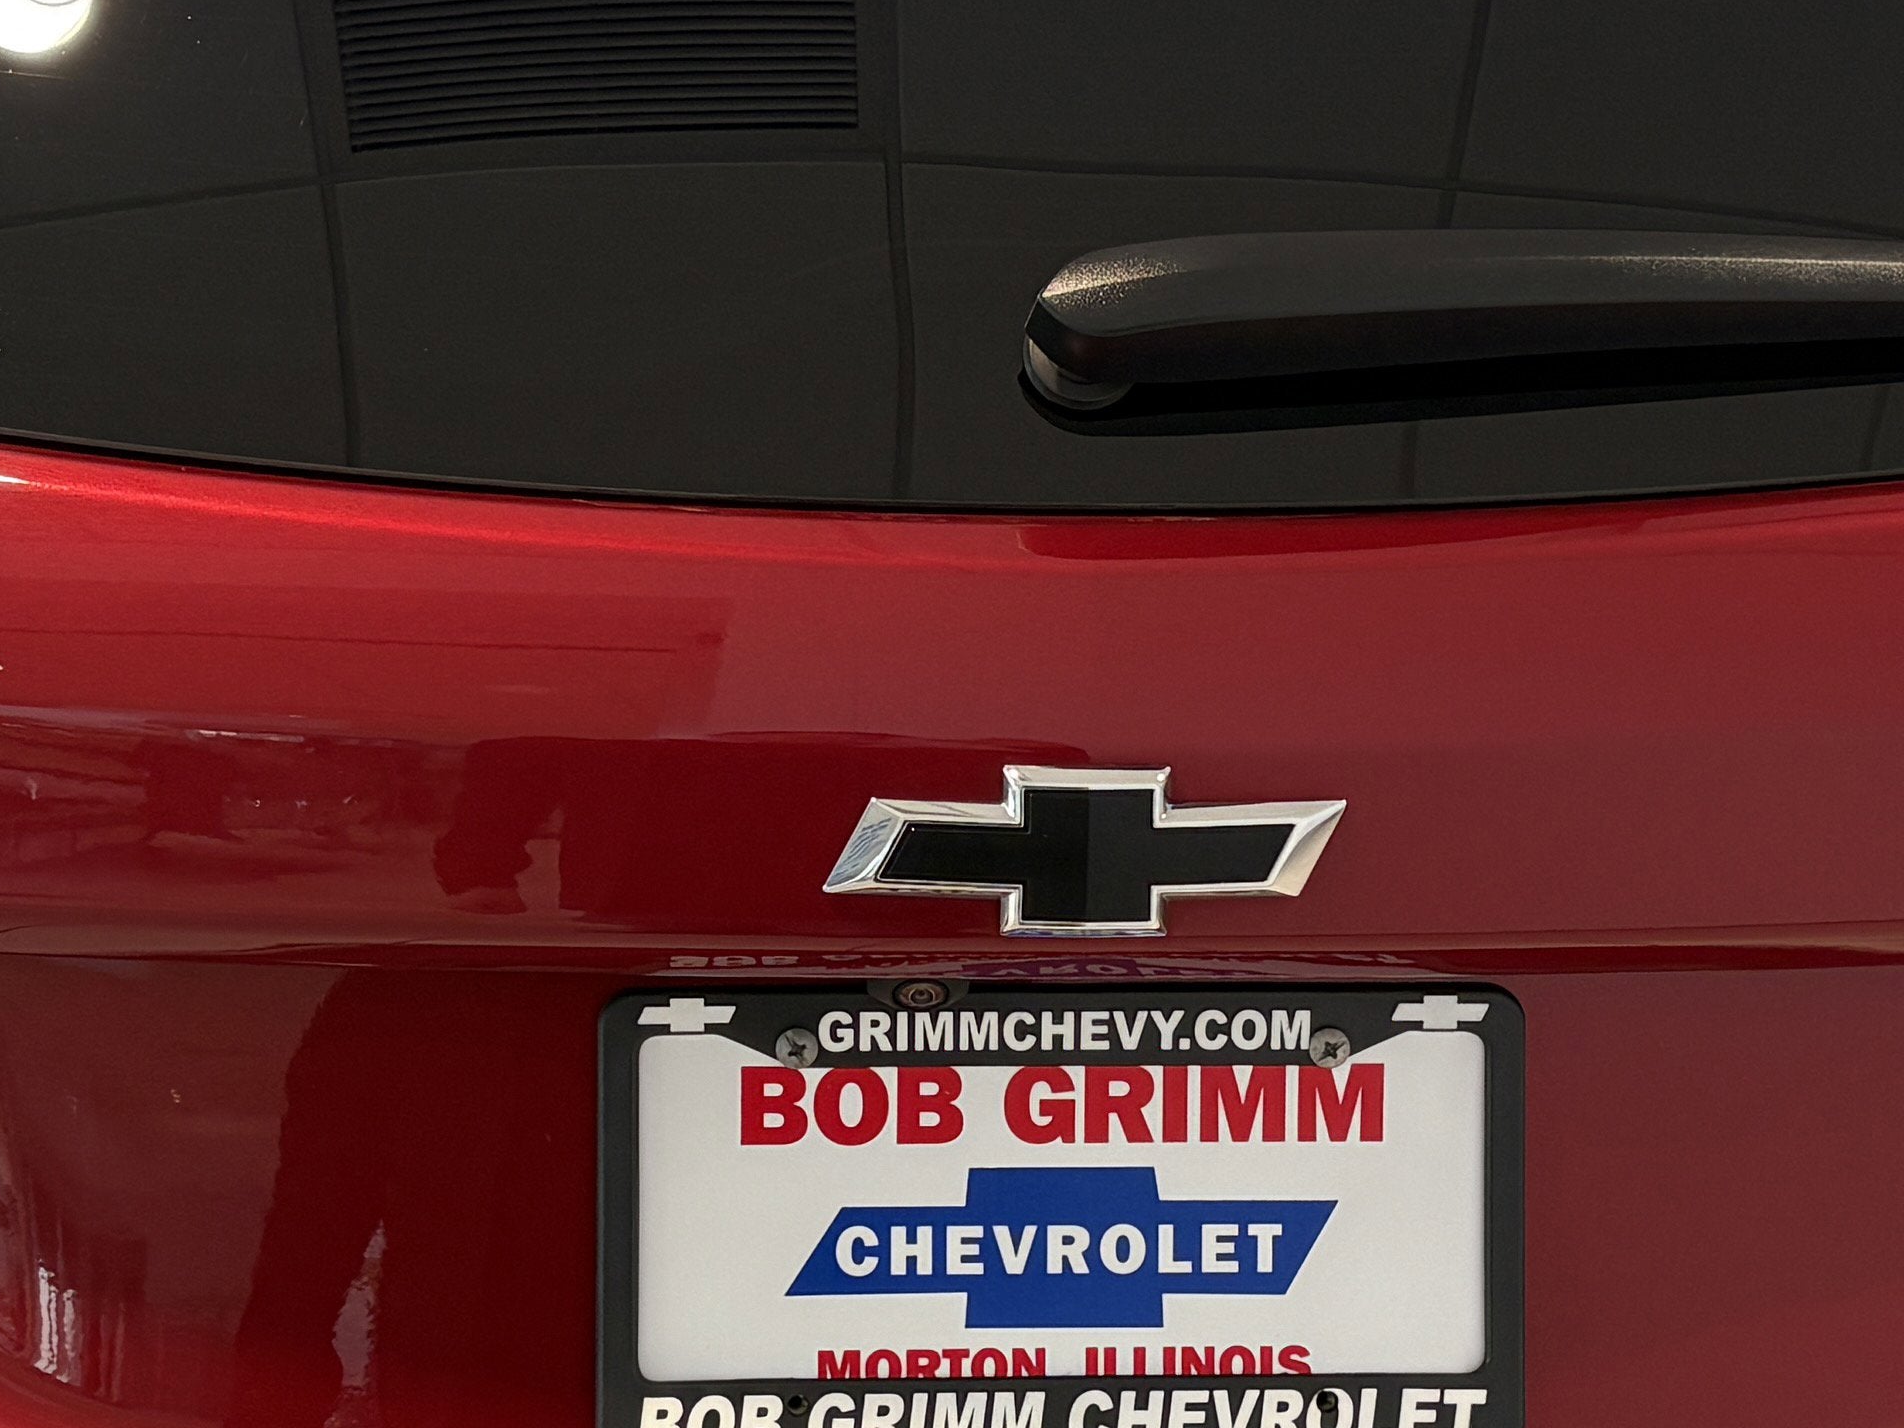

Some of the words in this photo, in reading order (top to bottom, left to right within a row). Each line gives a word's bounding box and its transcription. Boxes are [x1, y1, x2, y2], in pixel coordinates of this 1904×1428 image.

[817, 1010, 1313, 1053] GRIMMCHEVY.COM
[739, 1066, 965, 1146] BOB
[1003, 1063, 1385, 1144] GRIMM
[834, 1223, 1283, 1276] CHEVROLET
